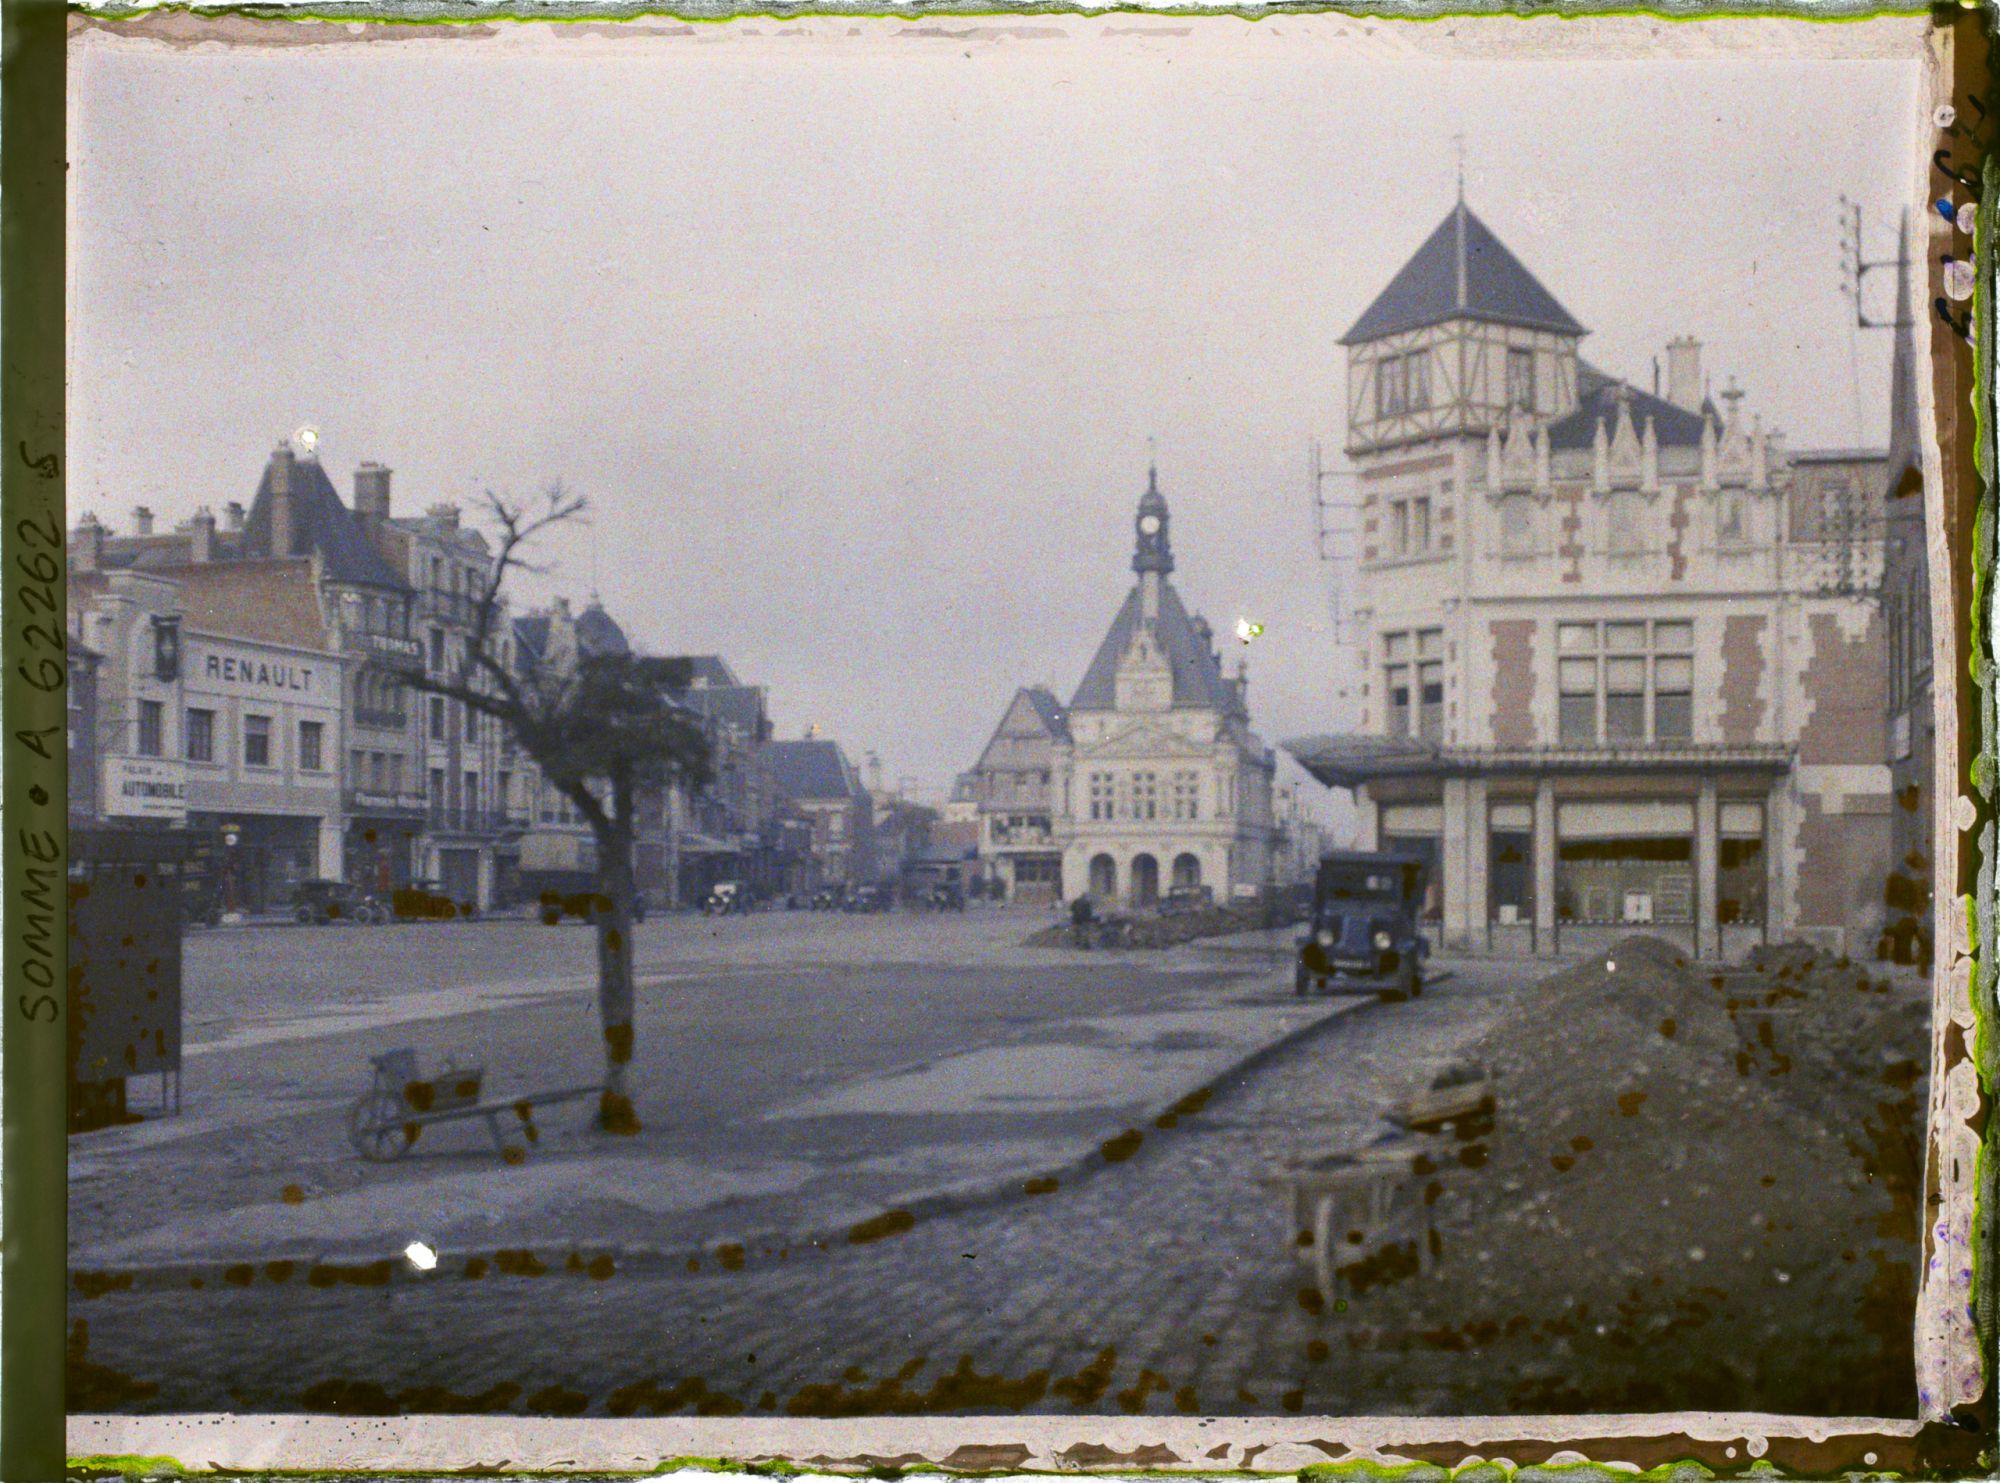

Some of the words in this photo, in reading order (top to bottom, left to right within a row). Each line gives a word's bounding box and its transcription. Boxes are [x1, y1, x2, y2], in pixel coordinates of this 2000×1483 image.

[17, 510, 63, 691] 62262
[207, 655, 313, 690] RENAULT
[15, 727, 59, 760] A
[19, 829, 59, 1023] SOMME
